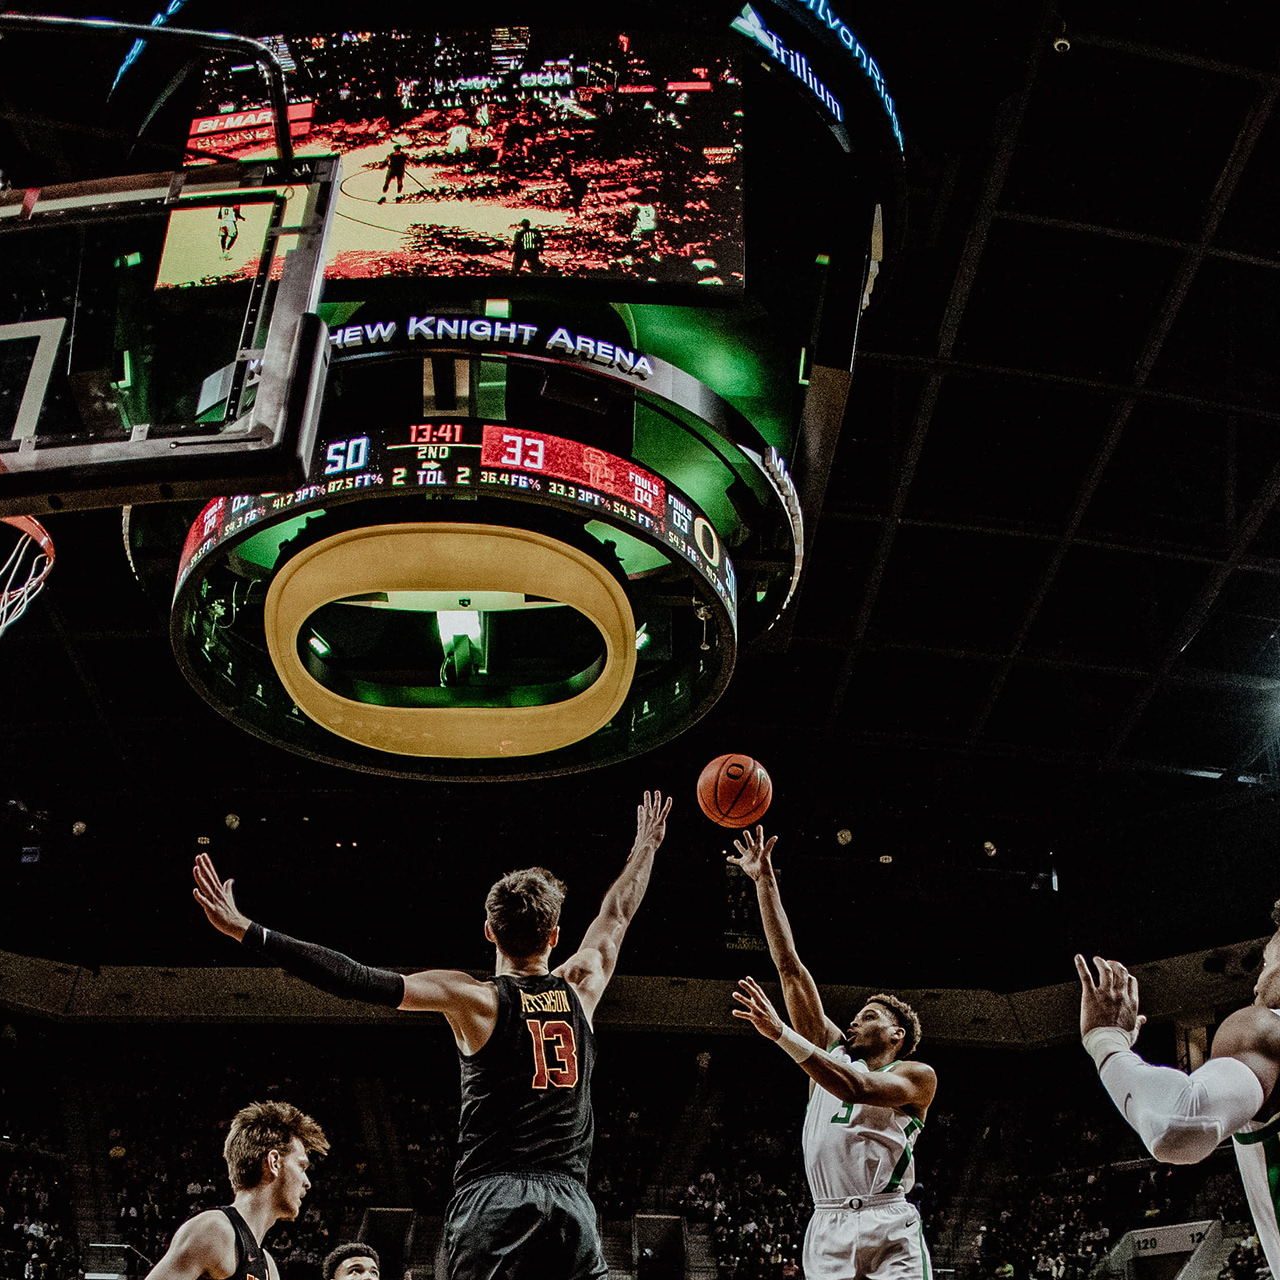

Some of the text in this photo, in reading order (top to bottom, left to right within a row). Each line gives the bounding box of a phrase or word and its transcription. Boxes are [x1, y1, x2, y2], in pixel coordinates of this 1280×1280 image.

[766, 30, 842, 121] Trillium
[197, 110, 273, 132] BI-MAR
[407, 316, 539, 346] KNIGHT
[546, 327, 654, 378] ARENA
[409, 425, 463, 444] 13:41
[323, 436, 370, 475] 50
[416, 446, 450, 460] 2ND
[501, 434, 546, 469] 33
[391, 466, 472, 486] 2 TOL 2
[480, 471, 510, 486] 36.4
[548, 482, 577, 499] 33.3
[628, 471, 660, 497] FOULS
[634, 488, 652, 508] 04
[668, 493, 693, 521] FOULS
[526, 1019, 578, 1089] 13
